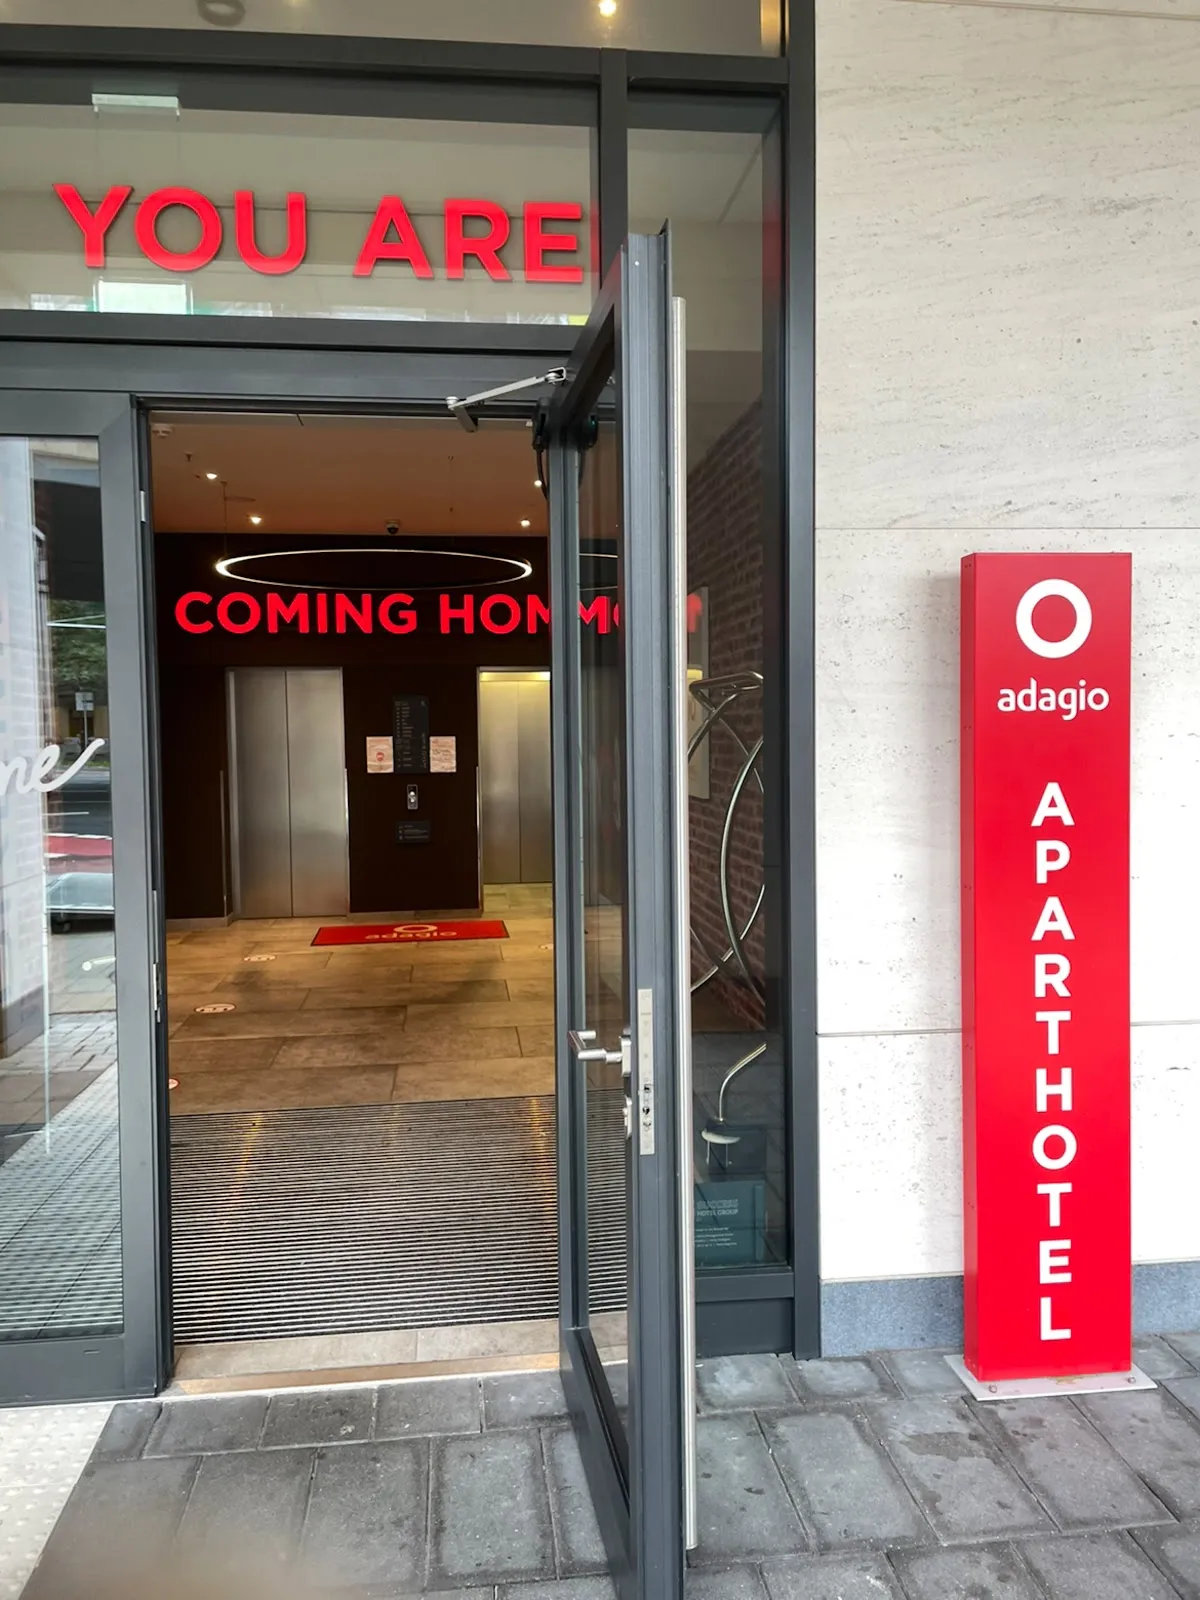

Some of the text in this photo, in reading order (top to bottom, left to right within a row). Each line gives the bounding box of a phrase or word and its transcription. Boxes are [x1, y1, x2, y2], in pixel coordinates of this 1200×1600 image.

[54, 183, 585, 284] YOU ARE
[174, 591, 418, 636] COMING
[997, 677, 1110, 721] adagio
[1031, 781, 1077, 1342] APARTHOTEL
